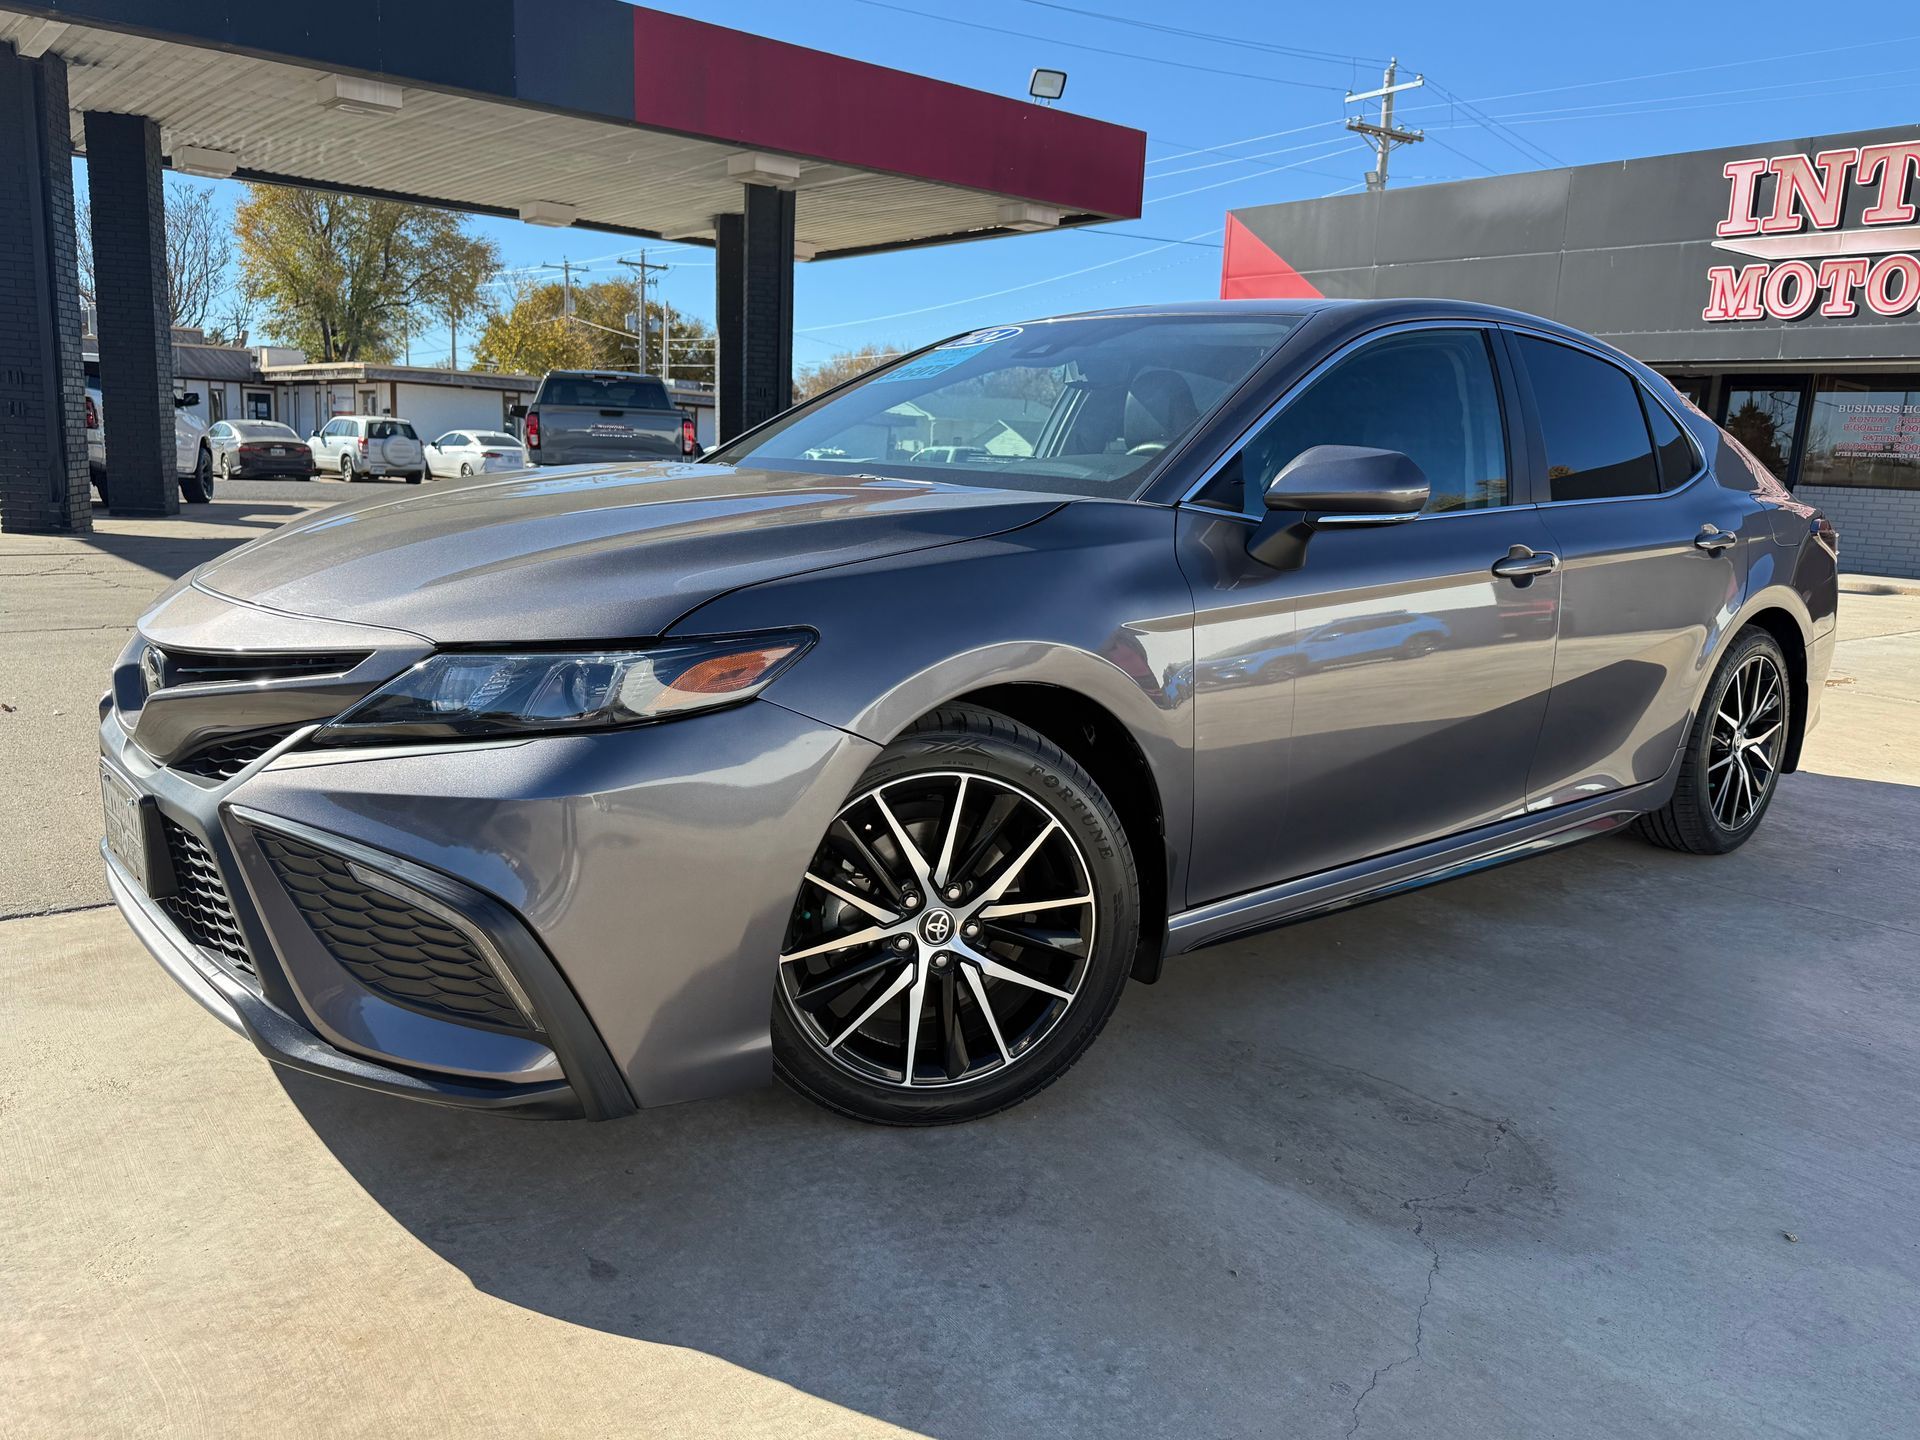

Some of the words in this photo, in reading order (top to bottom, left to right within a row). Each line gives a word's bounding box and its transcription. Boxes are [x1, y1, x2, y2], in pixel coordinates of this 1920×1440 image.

[1702, 254, 1920, 321] MOTO
[1838, 404, 1900, 413] BUSINESS
[1893, 442, 1920, 452] 2:00
[1025, 763, 1114, 860] FORTUNE
